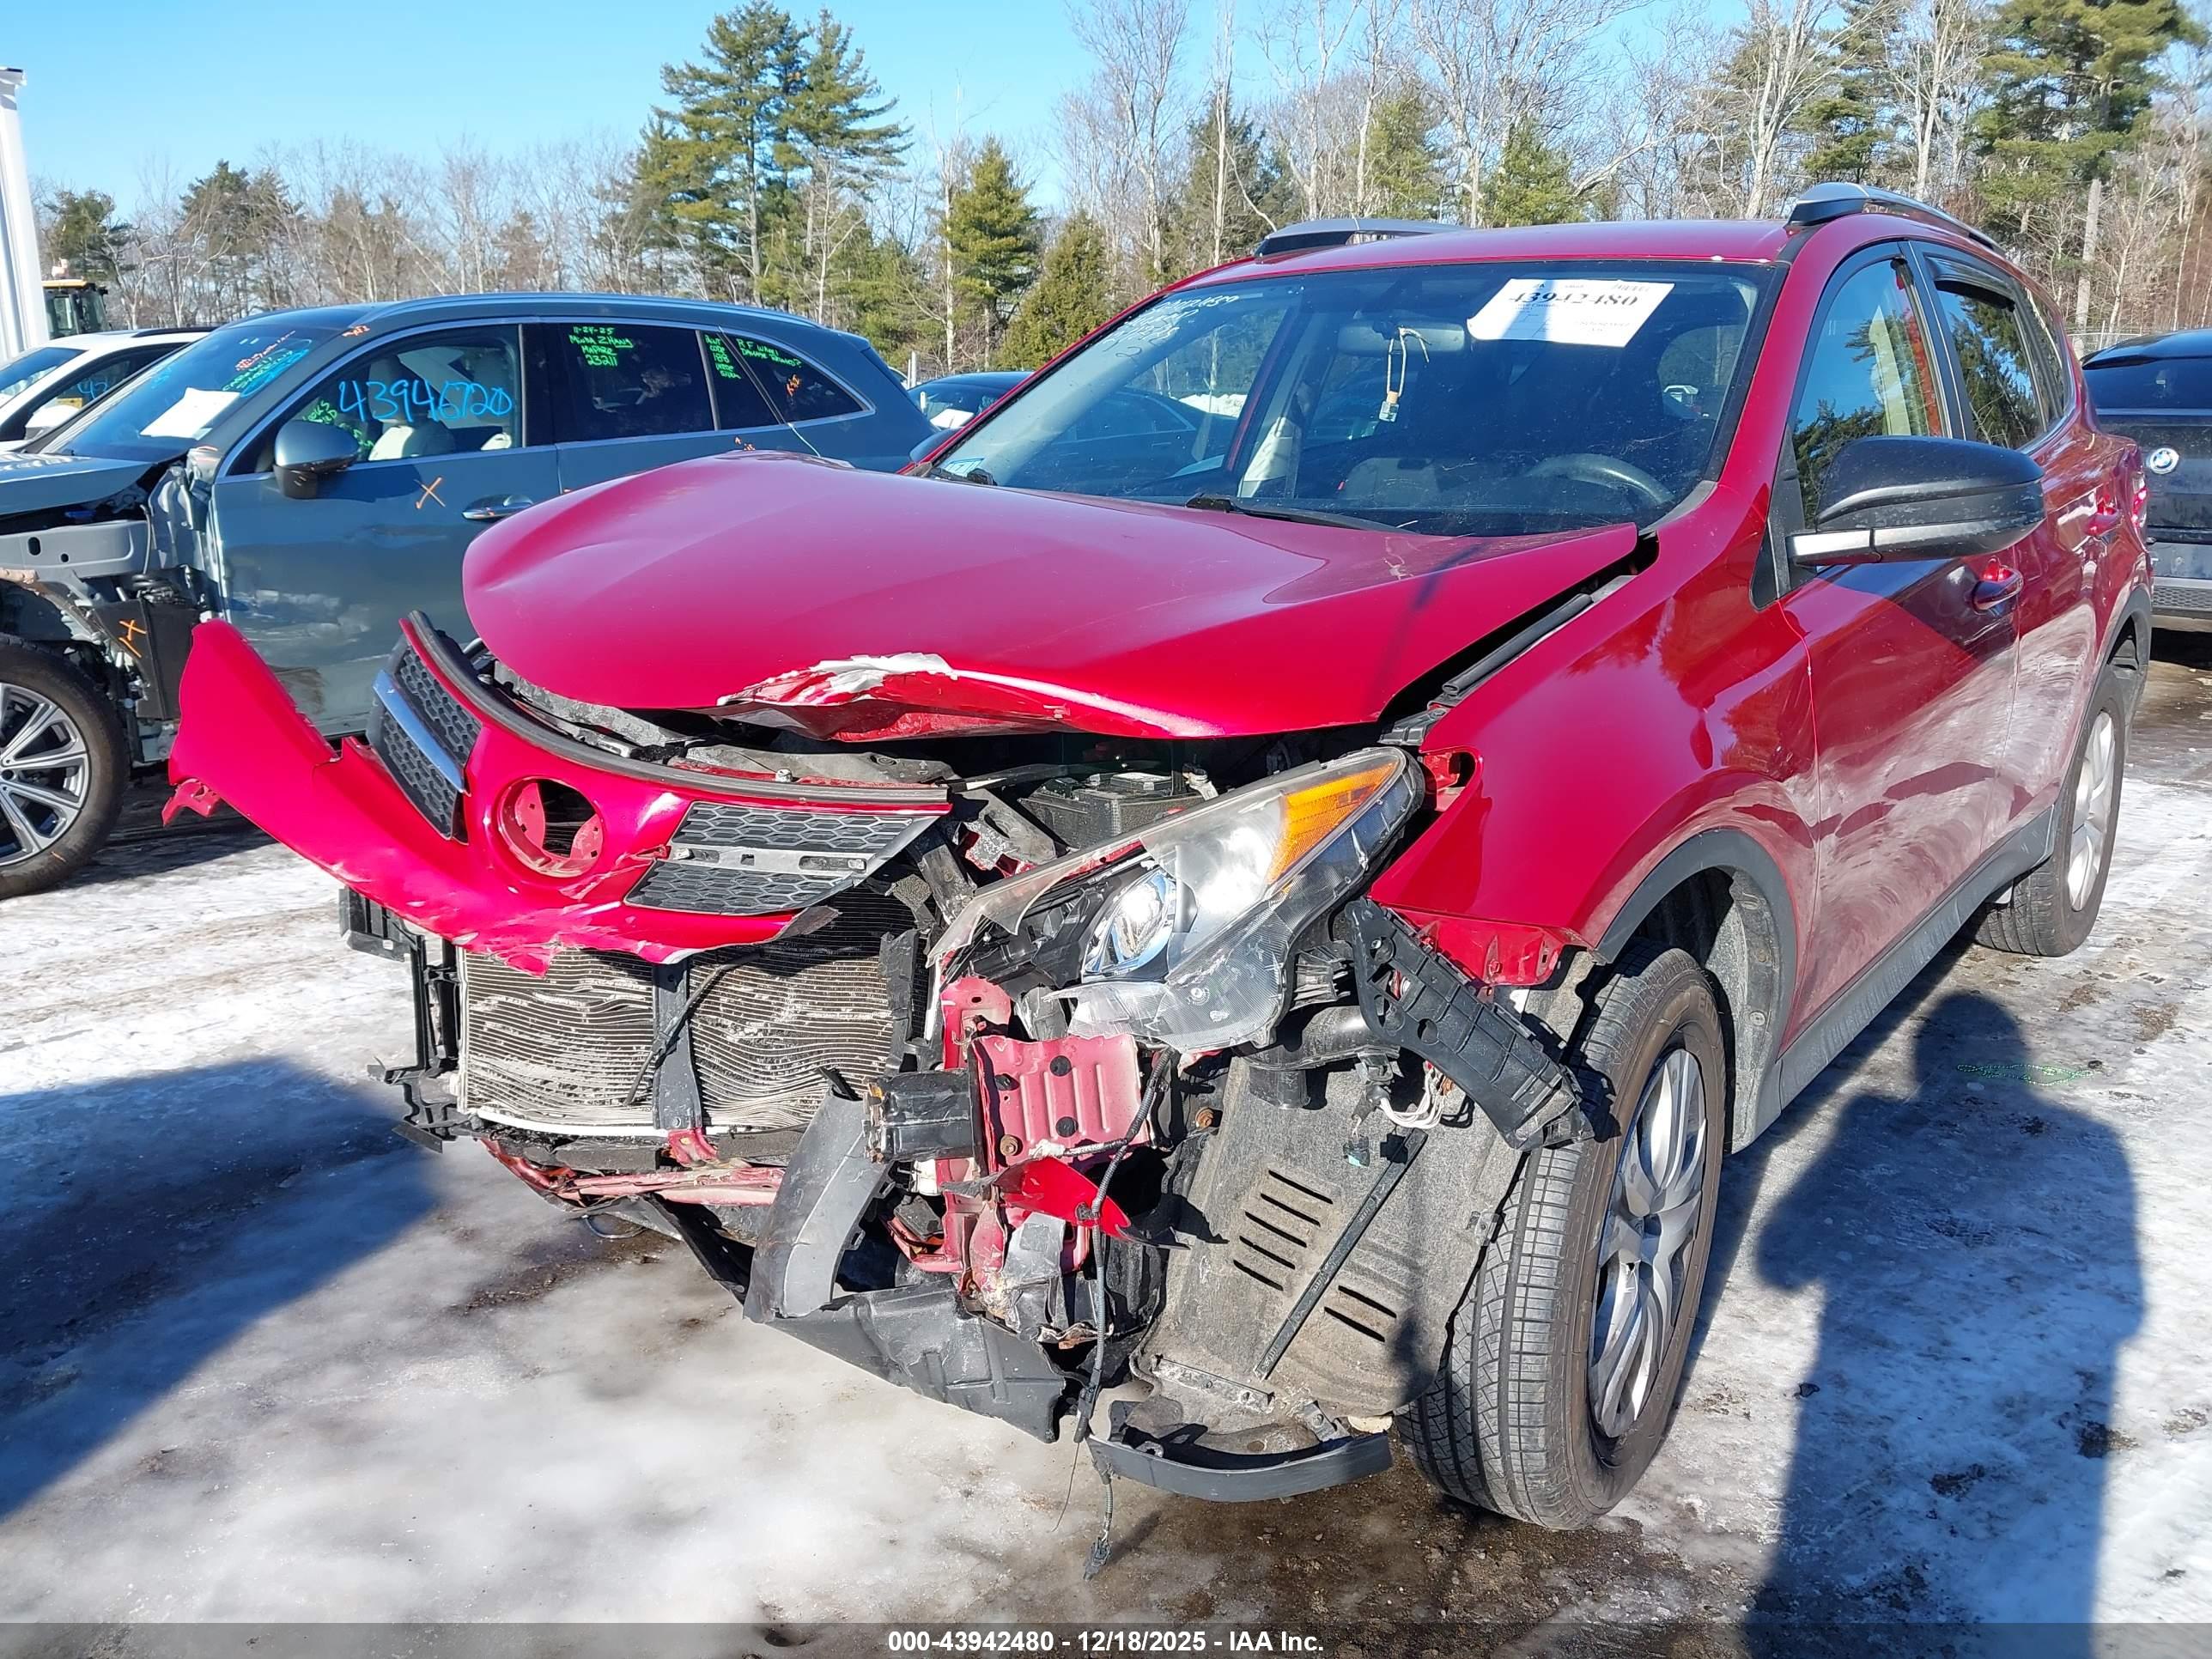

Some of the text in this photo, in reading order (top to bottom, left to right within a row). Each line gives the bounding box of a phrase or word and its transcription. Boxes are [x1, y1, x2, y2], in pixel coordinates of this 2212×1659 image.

[1509, 292, 1638, 307] 43942480
[585, 354, 618, 367] 23211
[337, 380, 513, 422] 43946720
